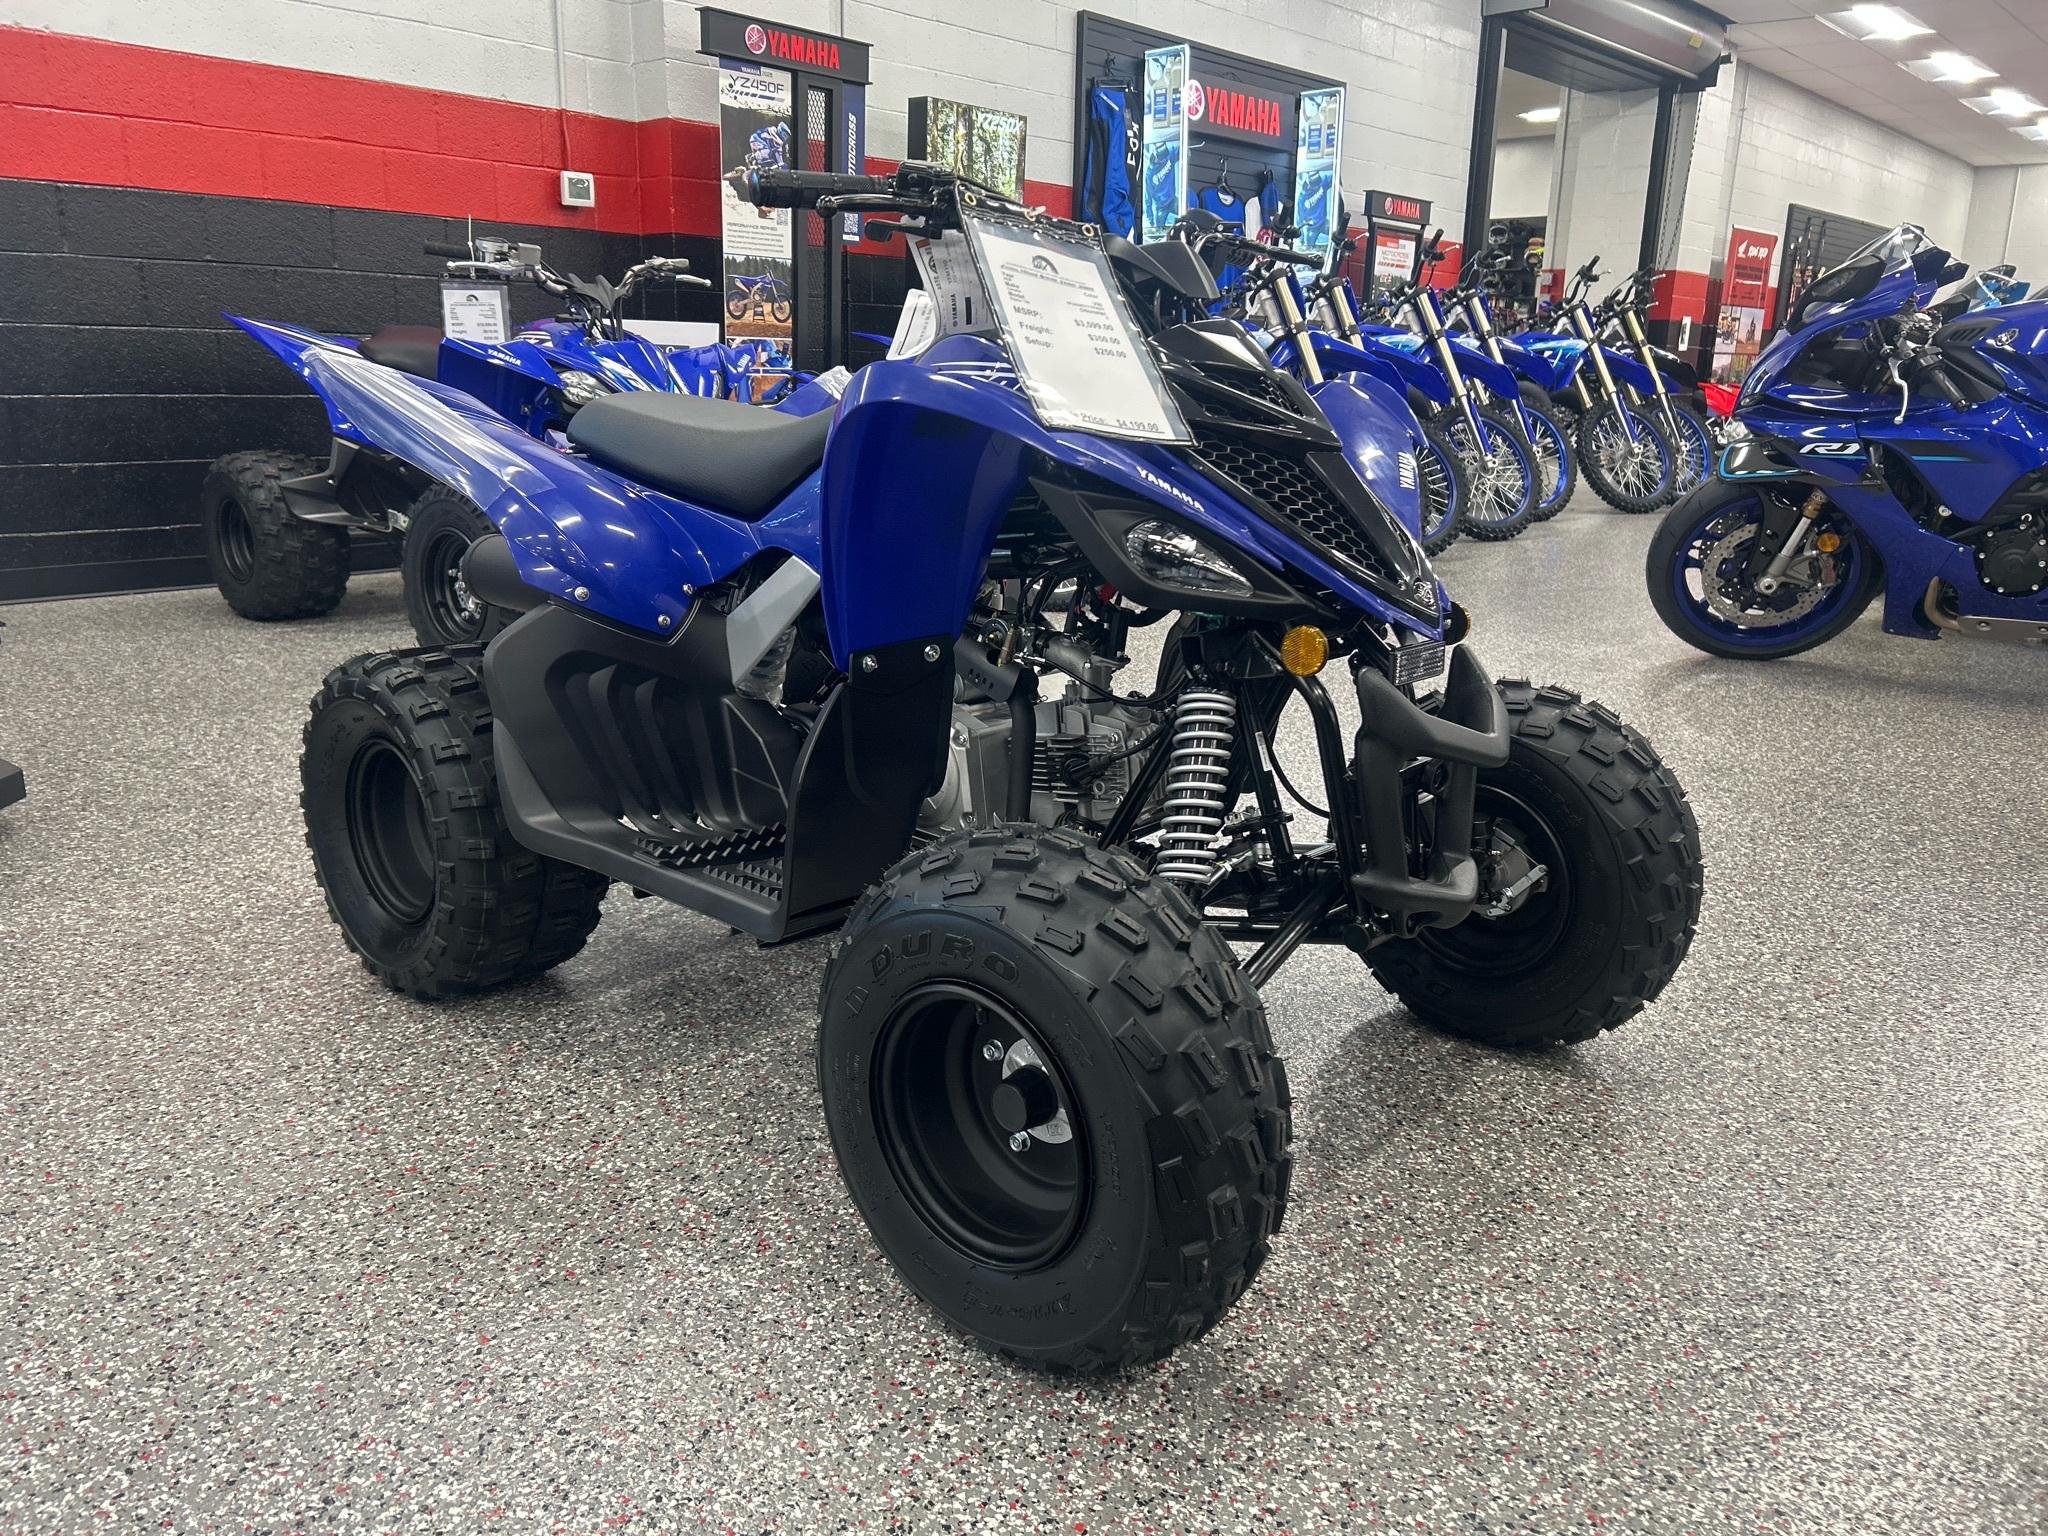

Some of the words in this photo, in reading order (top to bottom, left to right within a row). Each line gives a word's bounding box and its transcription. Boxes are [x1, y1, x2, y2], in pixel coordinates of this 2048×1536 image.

[767, 29, 840, 70] YAMAHA
[729, 74, 785, 95] YZ450F
[1206, 86, 1281, 137] YAMAHA
[848, 112, 857, 176] OTOCROSS
[1393, 199, 1420, 219] YAMAHA
[950, 293, 958, 317] YAMAHA
[1019, 321, 1053, 335] Freight:
[487, 349, 522, 366] YAMAHA
[1116, 418, 1159, 431] $4,199.00
[1397, 451, 1416, 490] YAMAHA
[1136, 465, 1205, 513] YAMAHA
[870, 929, 1019, 983] DURO
